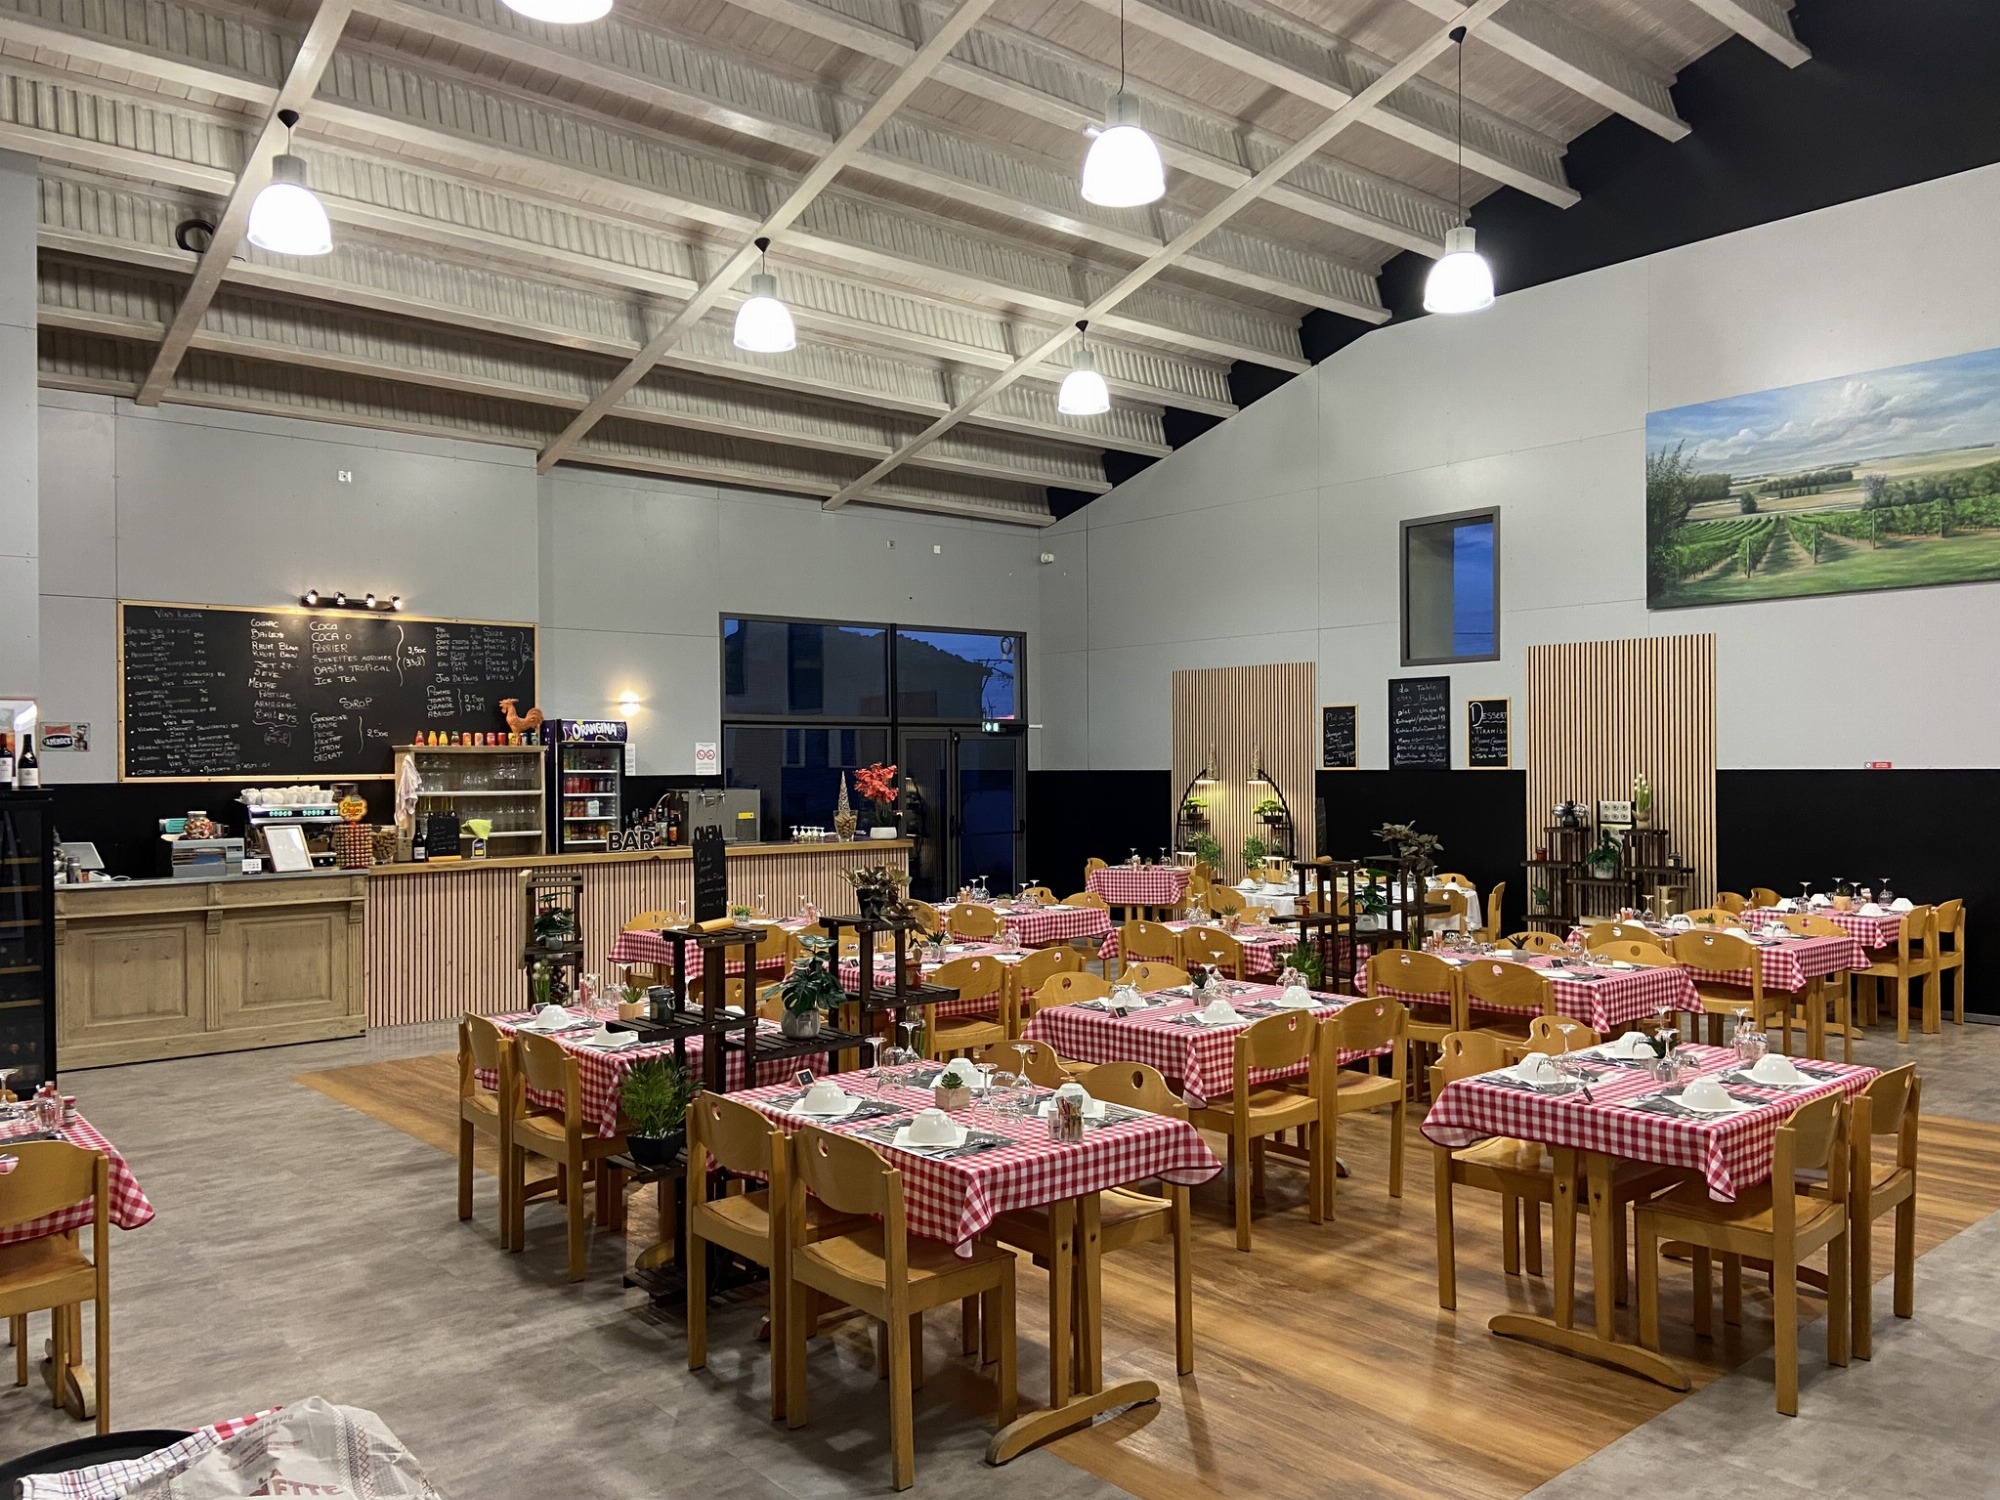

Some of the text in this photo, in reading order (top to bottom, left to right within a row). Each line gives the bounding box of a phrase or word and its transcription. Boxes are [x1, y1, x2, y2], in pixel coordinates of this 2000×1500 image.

[251, 618, 280, 628] COGNAC
[310, 631, 339, 641] COCA
[337, 675, 357, 683] TEA
[572, 722, 617, 740] ORANGINA
[607, 829, 656, 852] BAR
